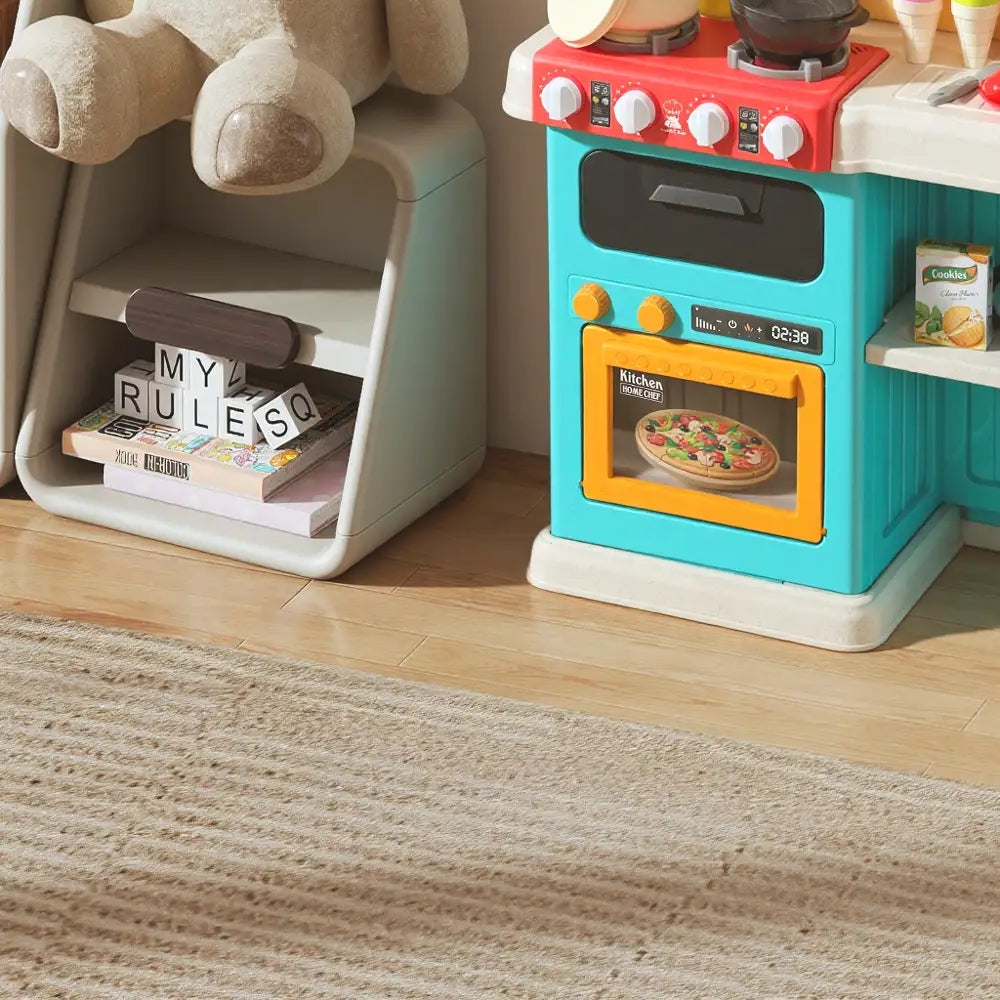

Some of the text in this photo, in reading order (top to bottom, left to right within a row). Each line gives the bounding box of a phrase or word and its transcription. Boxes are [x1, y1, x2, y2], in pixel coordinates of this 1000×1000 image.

[931, 269, 967, 280] Cookies
[771, 325, 810, 346] 02:38
[160, 349, 217, 388] MY
[620, 369, 664, 391] Kitchen
[622, 385, 661, 401] HOME CHEF
